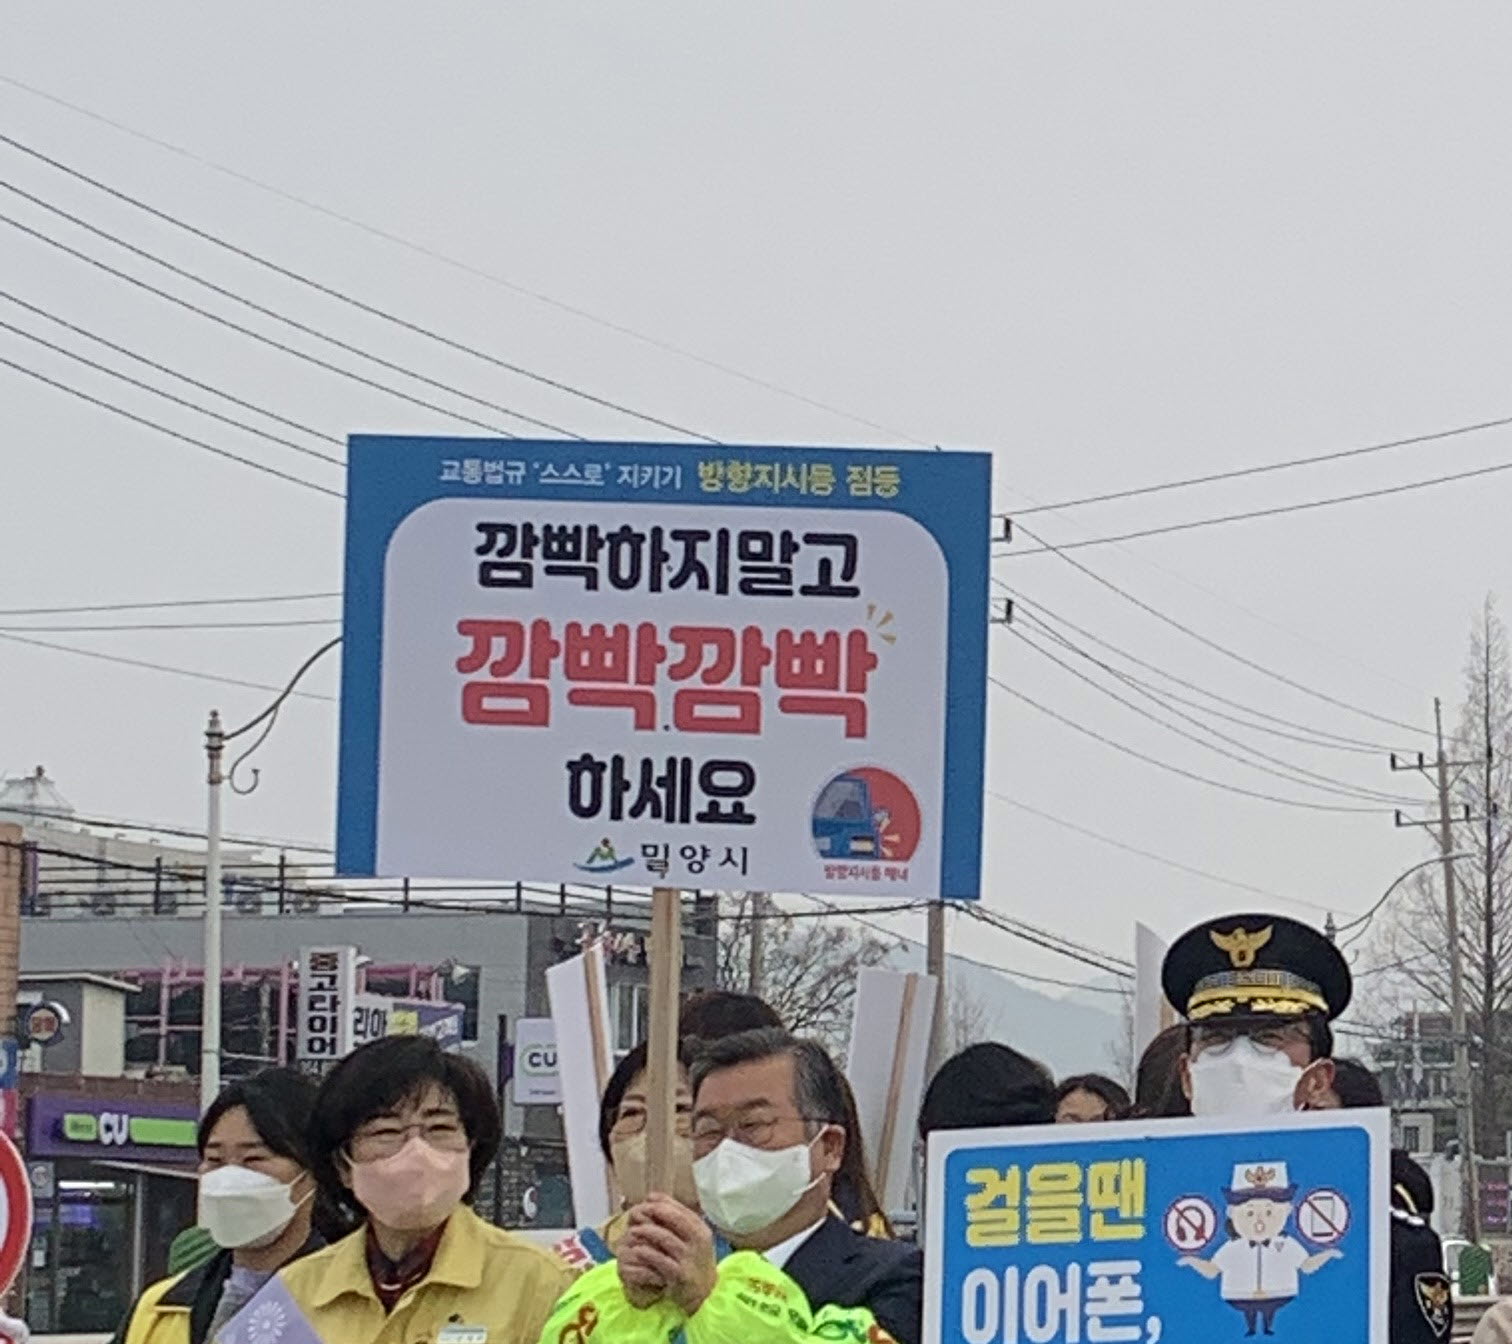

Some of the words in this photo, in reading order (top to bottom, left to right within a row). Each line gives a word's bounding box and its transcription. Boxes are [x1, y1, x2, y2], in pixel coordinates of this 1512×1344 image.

[438, 460, 527, 486] 교통법규
[616, 464, 682, 490] 지키기
[699, 462, 837, 497] 방향지시등
[845, 465, 902, 499] 점등
[475, 520, 861, 599] 깜빡하지말고
[456, 618, 879, 740] 깜빡깜빡
[565, 753, 758, 827] 하세요
[641, 843, 749, 880] 밀양시
[99, 1111, 129, 1146] CU
[965, 1157, 1147, 1249] 걸을땐
